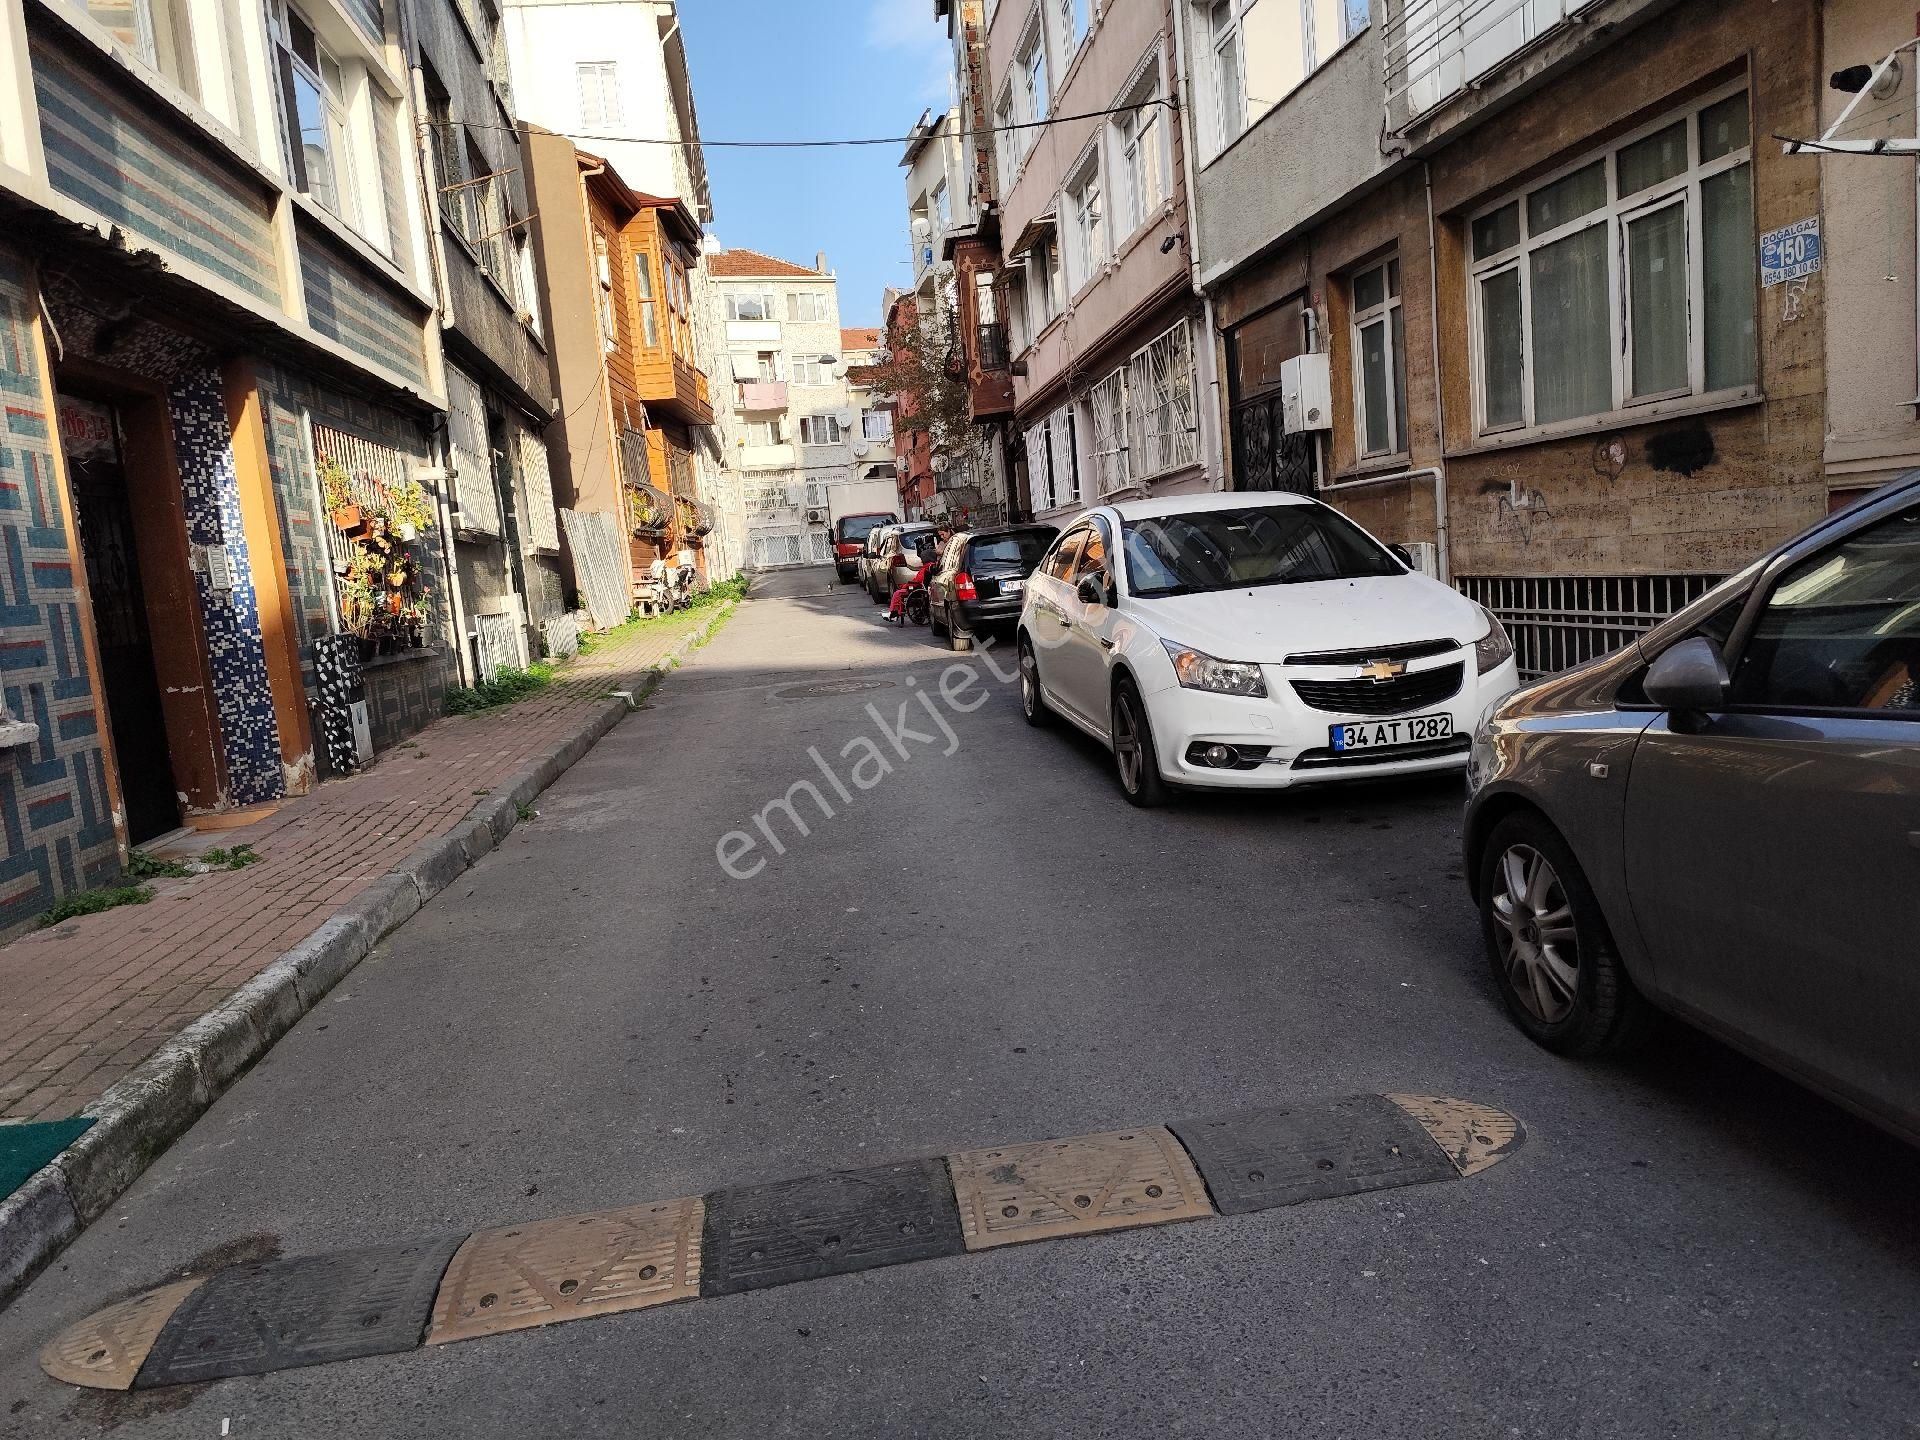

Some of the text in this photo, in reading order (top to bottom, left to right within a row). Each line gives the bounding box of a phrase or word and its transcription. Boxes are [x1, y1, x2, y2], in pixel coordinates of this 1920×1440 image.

[1777, 236, 1805, 267] 150
[1345, 727, 1368, 747] 34
[1375, 723, 1401, 744] AT
[1408, 718, 1449, 740] 1282
